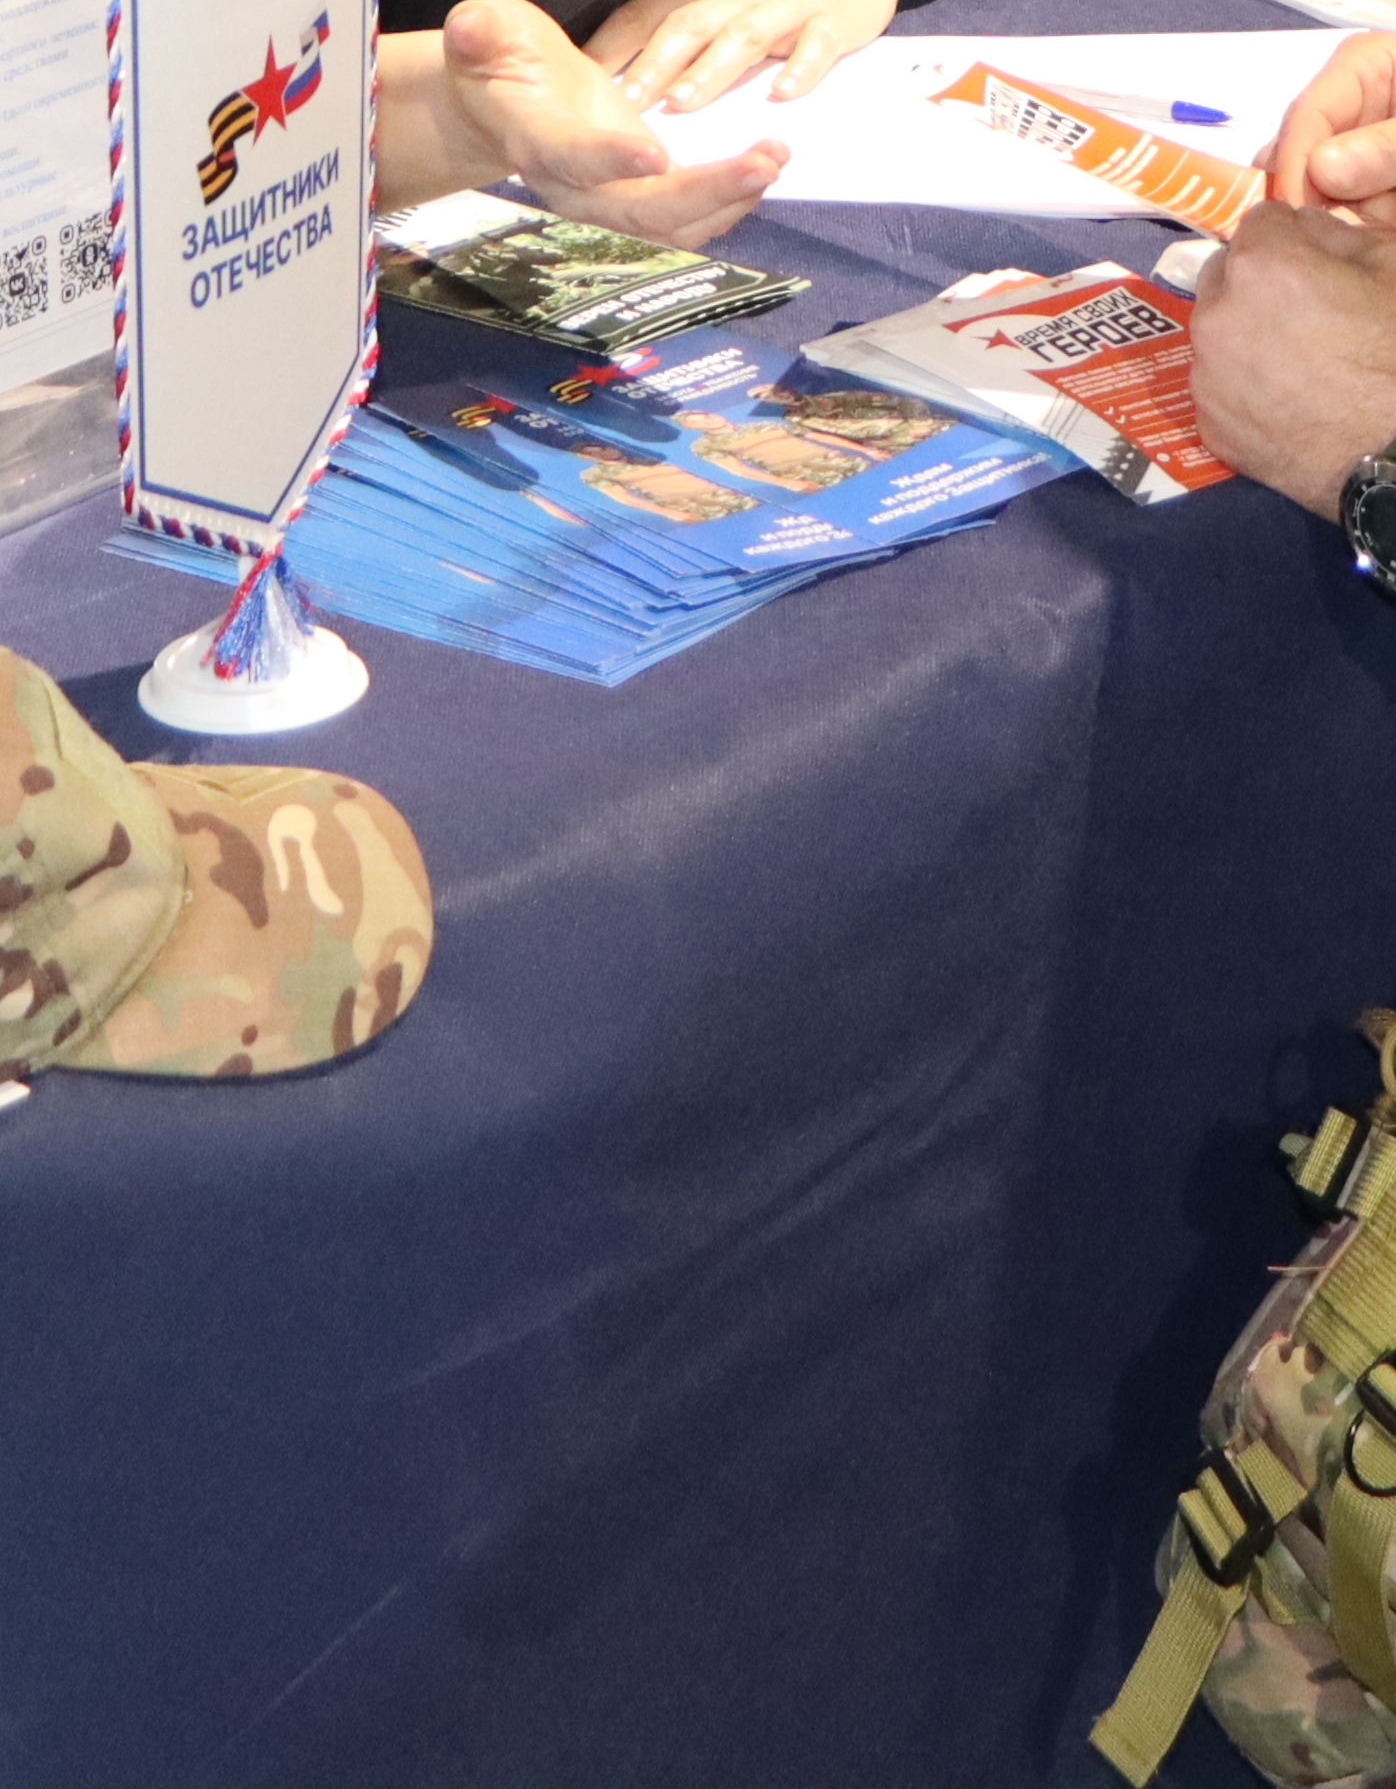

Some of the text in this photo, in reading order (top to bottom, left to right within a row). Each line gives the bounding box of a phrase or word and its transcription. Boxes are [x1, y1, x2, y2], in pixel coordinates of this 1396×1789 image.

[181, 148, 340, 263] ЗАЩИТНИКИ
[189, 203, 334, 310] ОТЕЧЕСТВА
[619, 265, 728, 303] ОТЕЧЕСТВУ
[633, 281, 719, 313] НАРОДУ
[1012, 289, 1139, 347] ВРЕМЯ СВОИХ
[1029, 304, 1183, 363] ГЕРОЕВ
[611, 347, 743, 394] ЗАЩИТНИКИ
[626, 359, 744, 400] ОТЕЧЕСТВА
[867, 493, 948, 525] каждого
